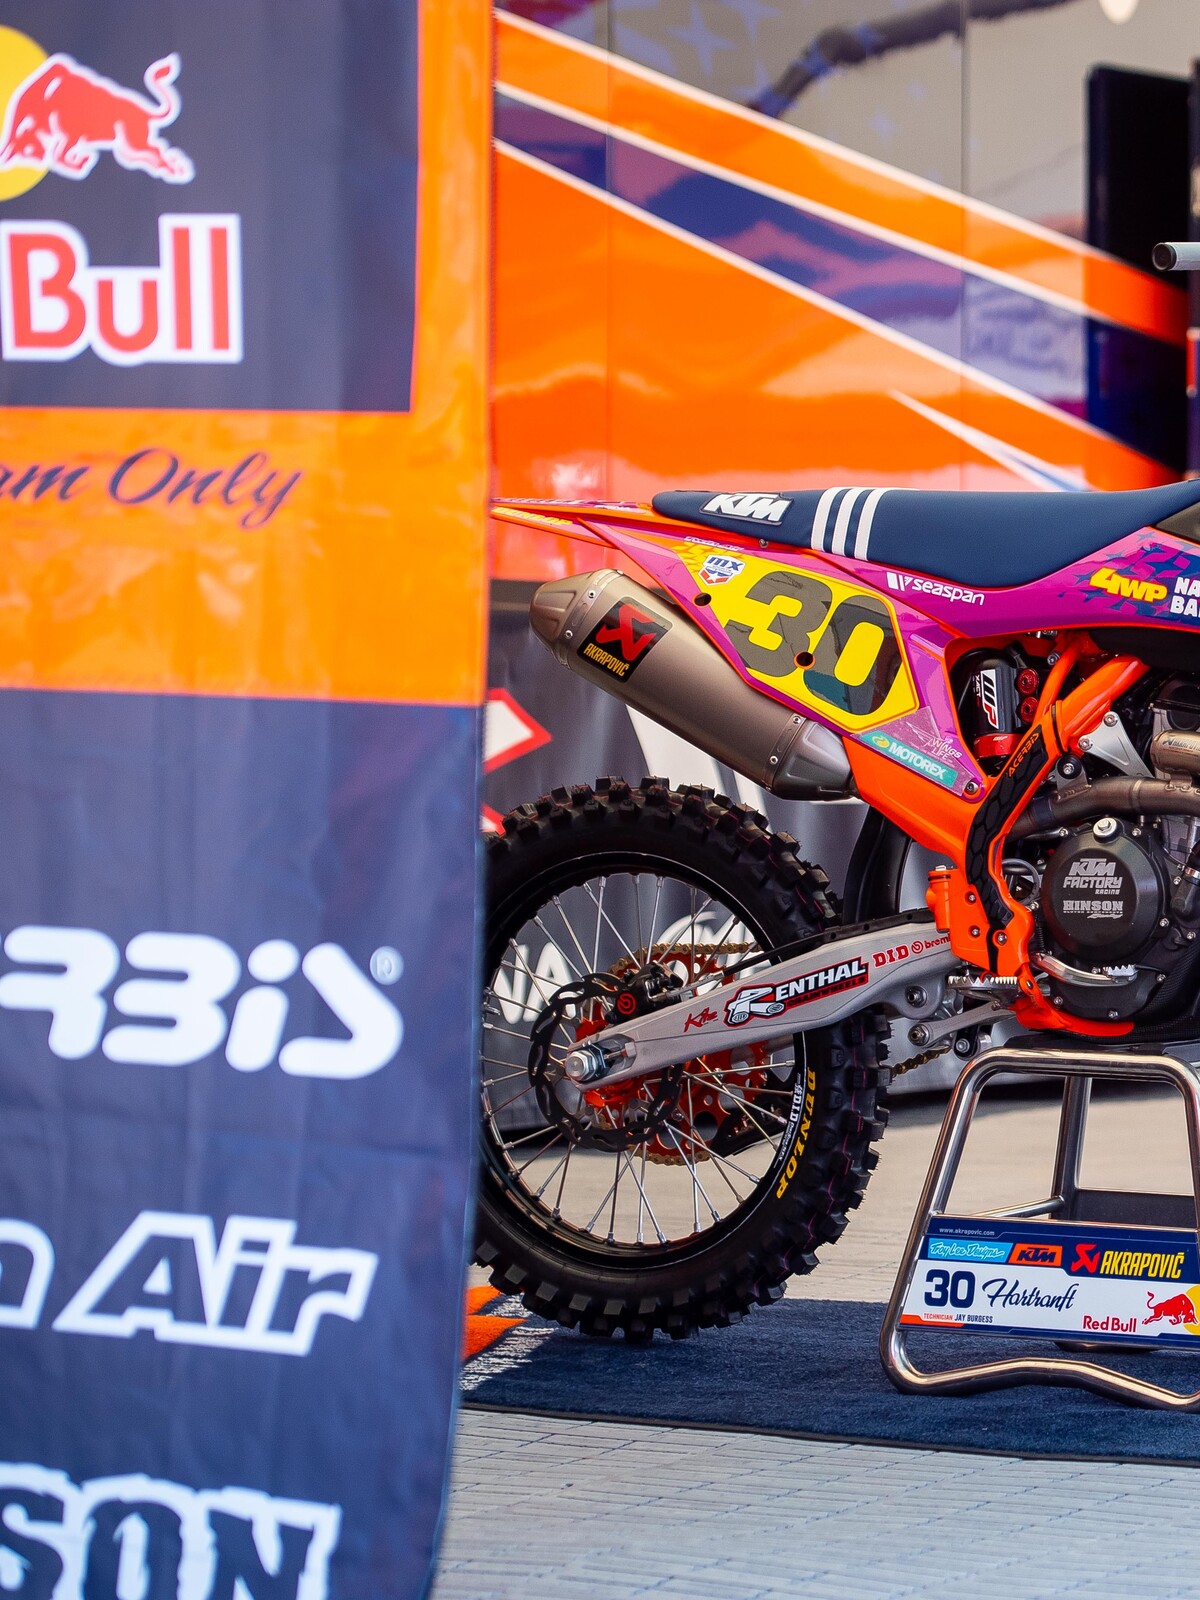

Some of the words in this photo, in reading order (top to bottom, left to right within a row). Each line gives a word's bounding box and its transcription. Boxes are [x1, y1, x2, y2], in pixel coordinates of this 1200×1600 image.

[7, 224, 232, 354] Bull
[109, 448, 302, 529] Only
[704, 494, 790, 522] KTM
[911, 580, 985, 606] seaspan
[1089, 567, 1168, 603] 4WP
[724, 571, 903, 716] 30
[888, 741, 948, 780] MOTOREX
[1063, 876, 1123, 889] FACTORY
[1068, 858, 1116, 876] KTM
[1063, 900, 1124, 911] HINSON
[728, 960, 868, 1025] RENTHAL
[776, 1066, 816, 1199] DUNLOP
[939, 1226, 996, 1237] www.akrapovic.com
[930, 1242, 950, 1257] Troy
[949, 1242, 968, 1257] Lee
[967, 1243, 1006, 1259] Designs
[1016, 1246, 1057, 1263] KTM
[52, 1210, 379, 1357] Air
[924, 1269, 977, 1309] 30
[981, 1277, 1080, 1313] Hartranft
[923, 1313, 953, 1321] TECHNICIAN
[954, 1313, 966, 1322] JAY
[966, 1315, 993, 1324] BURGESS
[1083, 1315, 1110, 1331] Red
[1111, 1317, 1138, 1333] Bull
